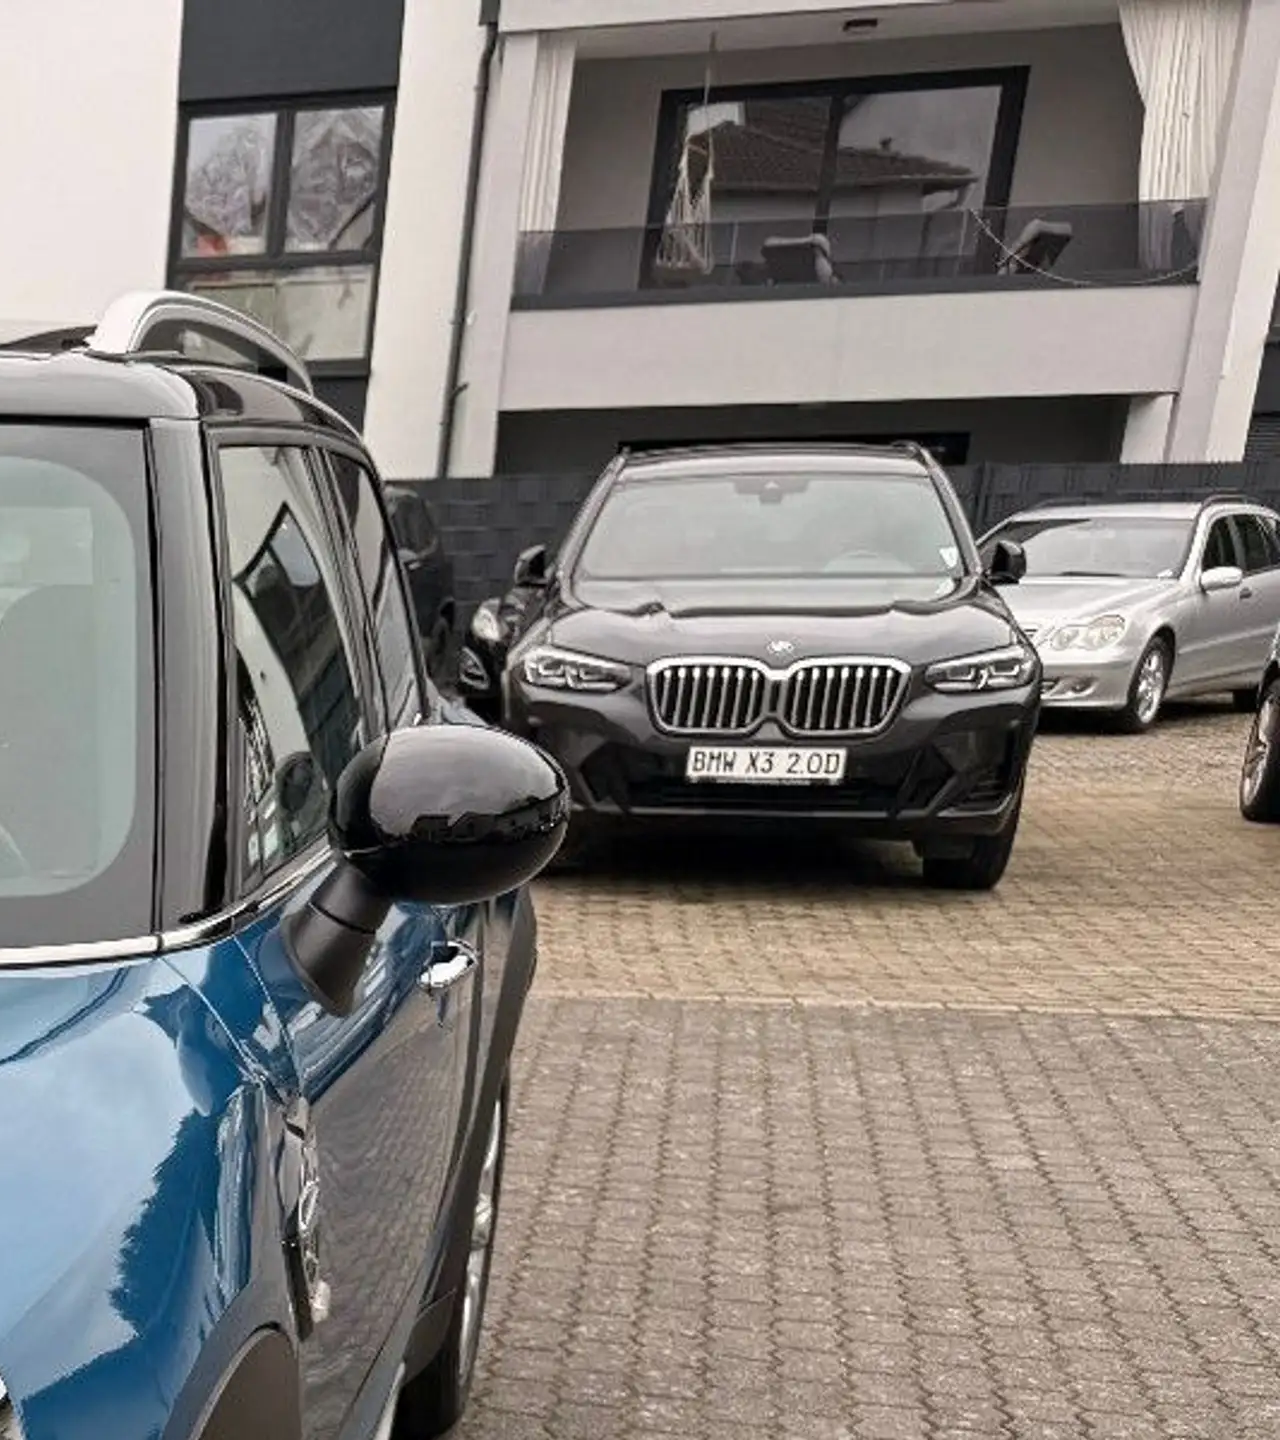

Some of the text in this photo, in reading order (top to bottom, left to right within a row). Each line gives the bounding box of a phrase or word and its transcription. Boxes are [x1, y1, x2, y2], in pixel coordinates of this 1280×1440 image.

[692, 751, 840, 774] BMW X3 2.0D
